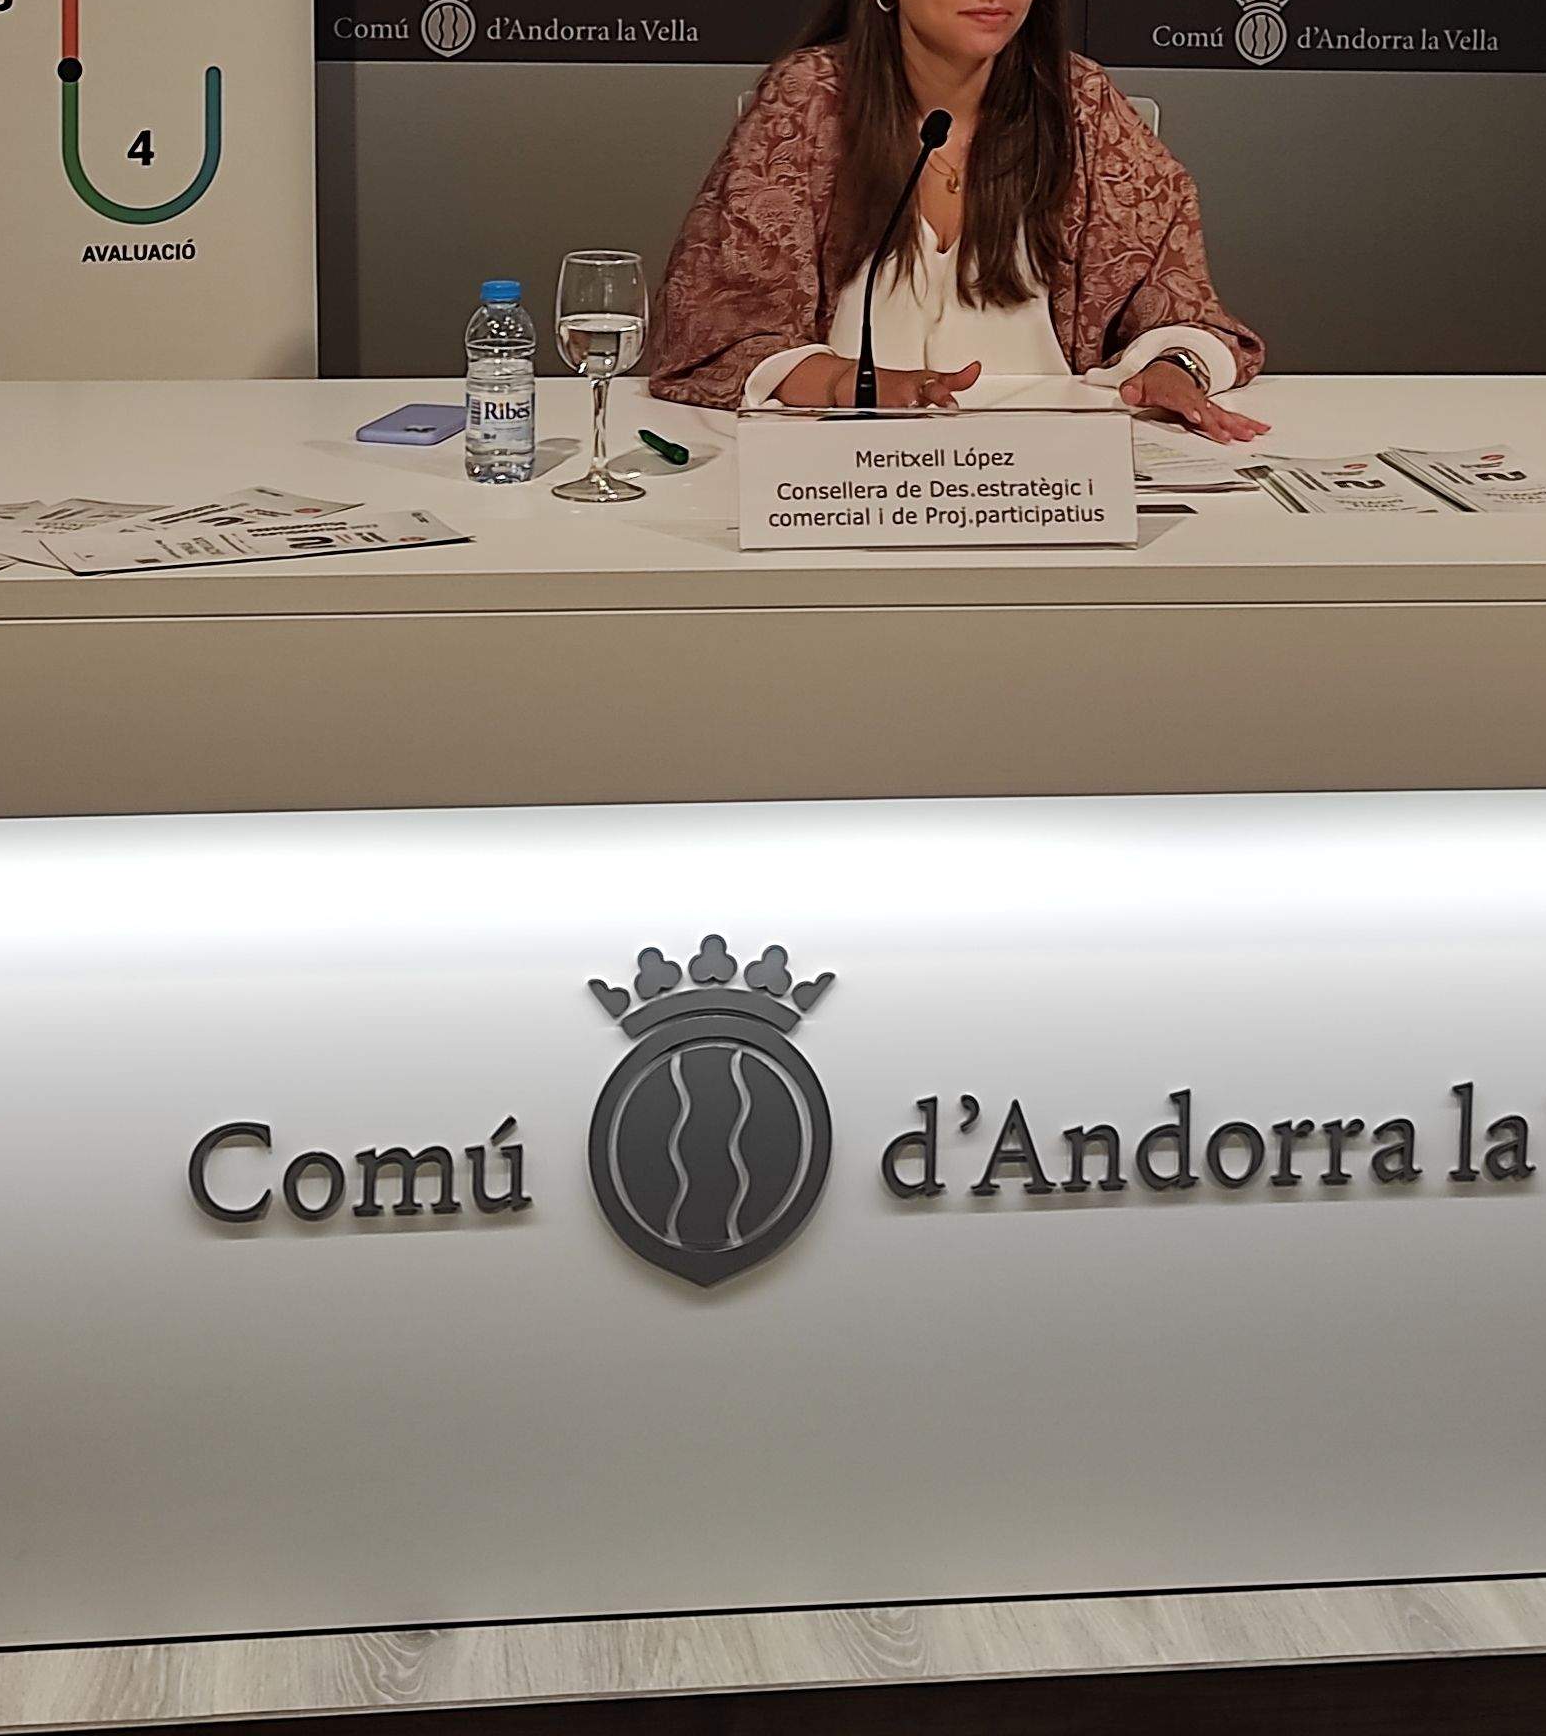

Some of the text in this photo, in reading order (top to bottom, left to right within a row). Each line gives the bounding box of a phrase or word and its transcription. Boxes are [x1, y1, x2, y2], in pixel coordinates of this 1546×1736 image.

[333, 17, 409, 40] Comú
[617, 19, 637, 41] la
[640, 20, 699, 42] Vella
[1152, 25, 1224, 49] Comú
[1420, 28, 1441, 51] la
[1444, 29, 1499, 52] Vella
[127, 130, 155, 167] 4
[81, 241, 196, 264] AVALUACIÓ
[855, 448, 1015, 472] Meritxell López
[777, 478, 1093, 502] Consellera de Des.estratègic i
[768, 505, 1105, 528] comercial i de Proj.participatius
[186, 1116, 534, 1224] Comú
[879, 1089, 1422, 1202] d'Andorra
[1447, 1082, 1537, 1184] la
